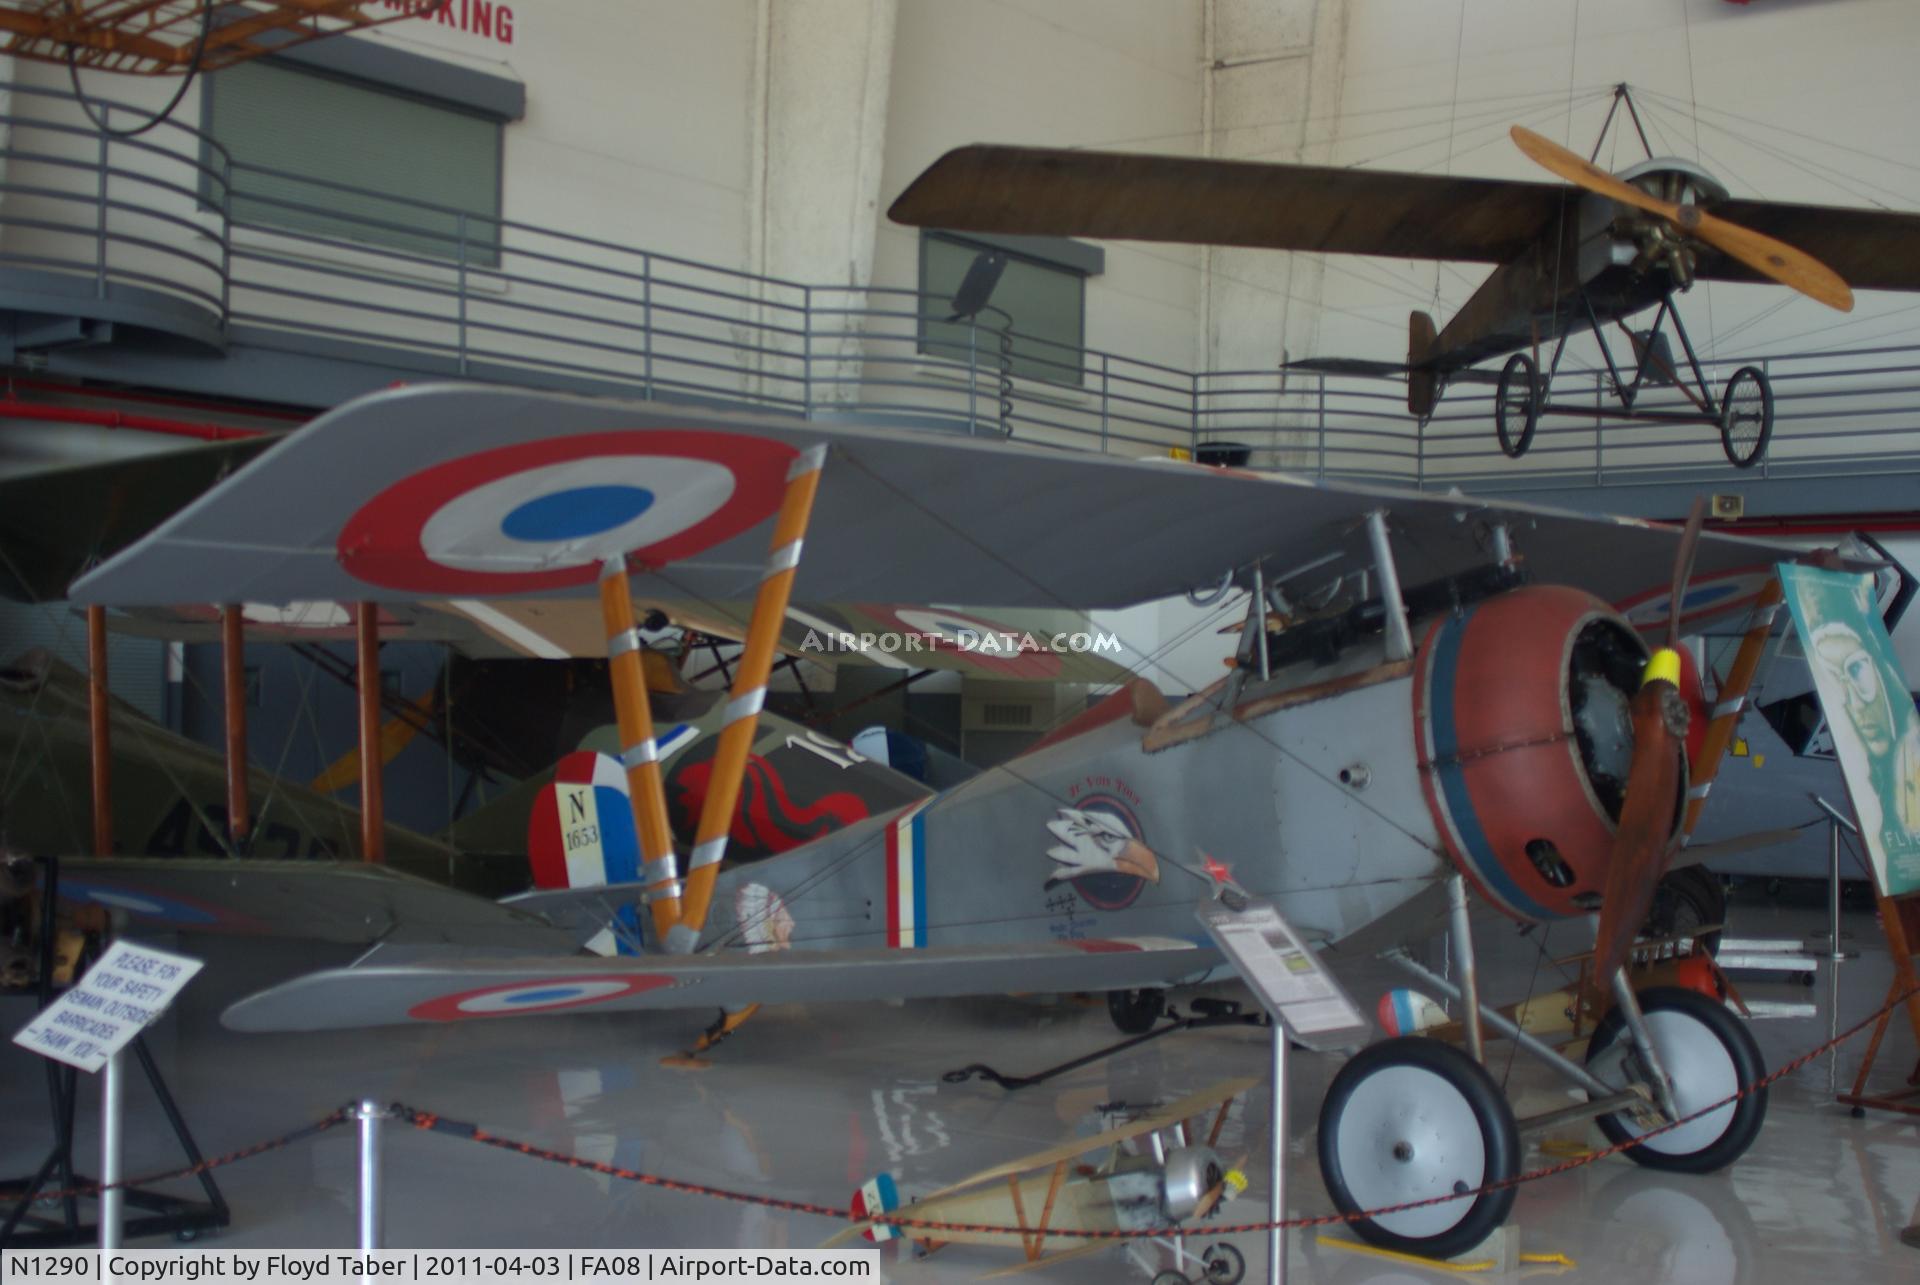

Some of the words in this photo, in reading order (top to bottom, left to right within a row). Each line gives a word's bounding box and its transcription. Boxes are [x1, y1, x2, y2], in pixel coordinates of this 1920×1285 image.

[568, 790, 585, 824] N
[566, 825, 598, 851] 1653
[112, 951, 160, 975] PLEASE
[154, 963, 182, 982] FOR
[64, 989, 105, 1011] REMAIN
[94, 971, 124, 990] YOUR
[120, 980, 167, 1002] SAFETY
[53, 1010, 120, 1040] BARRICADES
